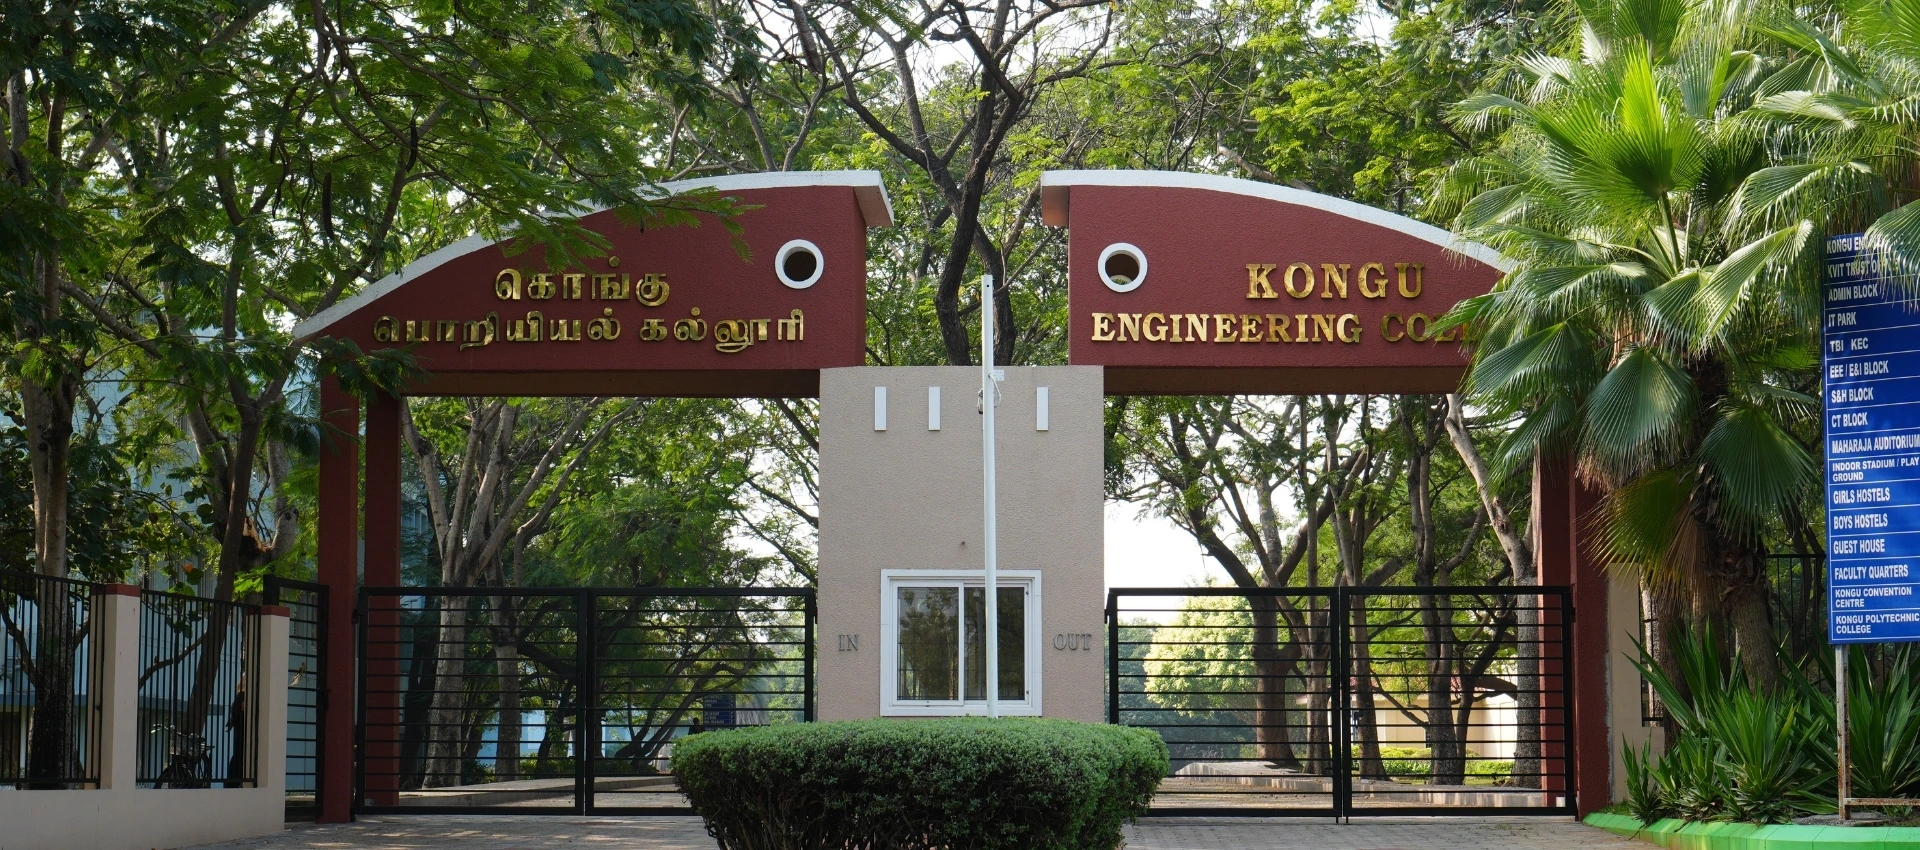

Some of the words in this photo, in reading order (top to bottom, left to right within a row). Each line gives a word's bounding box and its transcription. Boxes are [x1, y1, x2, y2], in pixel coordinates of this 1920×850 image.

[1827, 237, 1852, 254] KONGU
[1828, 263, 1844, 278] KVIT
[1846, 260, 1870, 276] TRUST
[495, 255, 670, 306] கொங்கு
[1245, 262, 1424, 299] KONGU
[1828, 286, 1852, 302] ADMIN
[1853, 283, 1878, 300] BLOCK
[1091, 312, 1363, 343] ENGINEERING
[1828, 313, 1835, 327] IT
[1837, 311, 1857, 326] PARK
[373, 307, 621, 352] பொறியியல்
[639, 307, 804, 353] கல்லூரி
[1830, 339, 1844, 353] TBI
[1851, 337, 1869, 351] KEC
[1830, 364, 1844, 379] EEE
[1849, 363, 1862, 377] E&I
[1863, 360, 1889, 376] BLOCK
[1831, 389, 1847, 403] S&H
[1849, 387, 1874, 402] BLOCK
[1831, 414, 1842, 428] CT
[1843, 411, 1868, 427] BLOCK
[1832, 437, 1872, 454] MAHARAJA
[1874, 434, 1920, 451] AUDITORIUM
[1832, 461, 1861, 472] INDOOR
[1862, 458, 1895, 470] STADIUM
[1900, 456, 1920, 467] PLAY
[1832, 471, 1864, 482] GROUND
[1833, 489, 1855, 504] GIRLS
[1856, 487, 1890, 503] HOSTELS
[1833, 515, 1852, 530] BOYS
[1854, 513, 1888, 529] HOSTELS
[1833, 540, 1858, 555] GUEST
[1859, 538, 1885, 553] HOUSE
[1834, 566, 1867, 581] FACULTY
[1868, 564, 1909, 579] QUARTERS
[1835, 588, 1862, 598] KONGU
[1863, 586, 1912, 597] CONVENTION
[1835, 598, 1864, 608] CENTRE
[1835, 614, 1864, 625] KONGU
[1865, 612, 1920, 624] POLYTECHNIC
[1836, 624, 1872, 634] COLLEGE
[838, 634, 859, 651] IN
[1053, 633, 1092, 651] OUT
